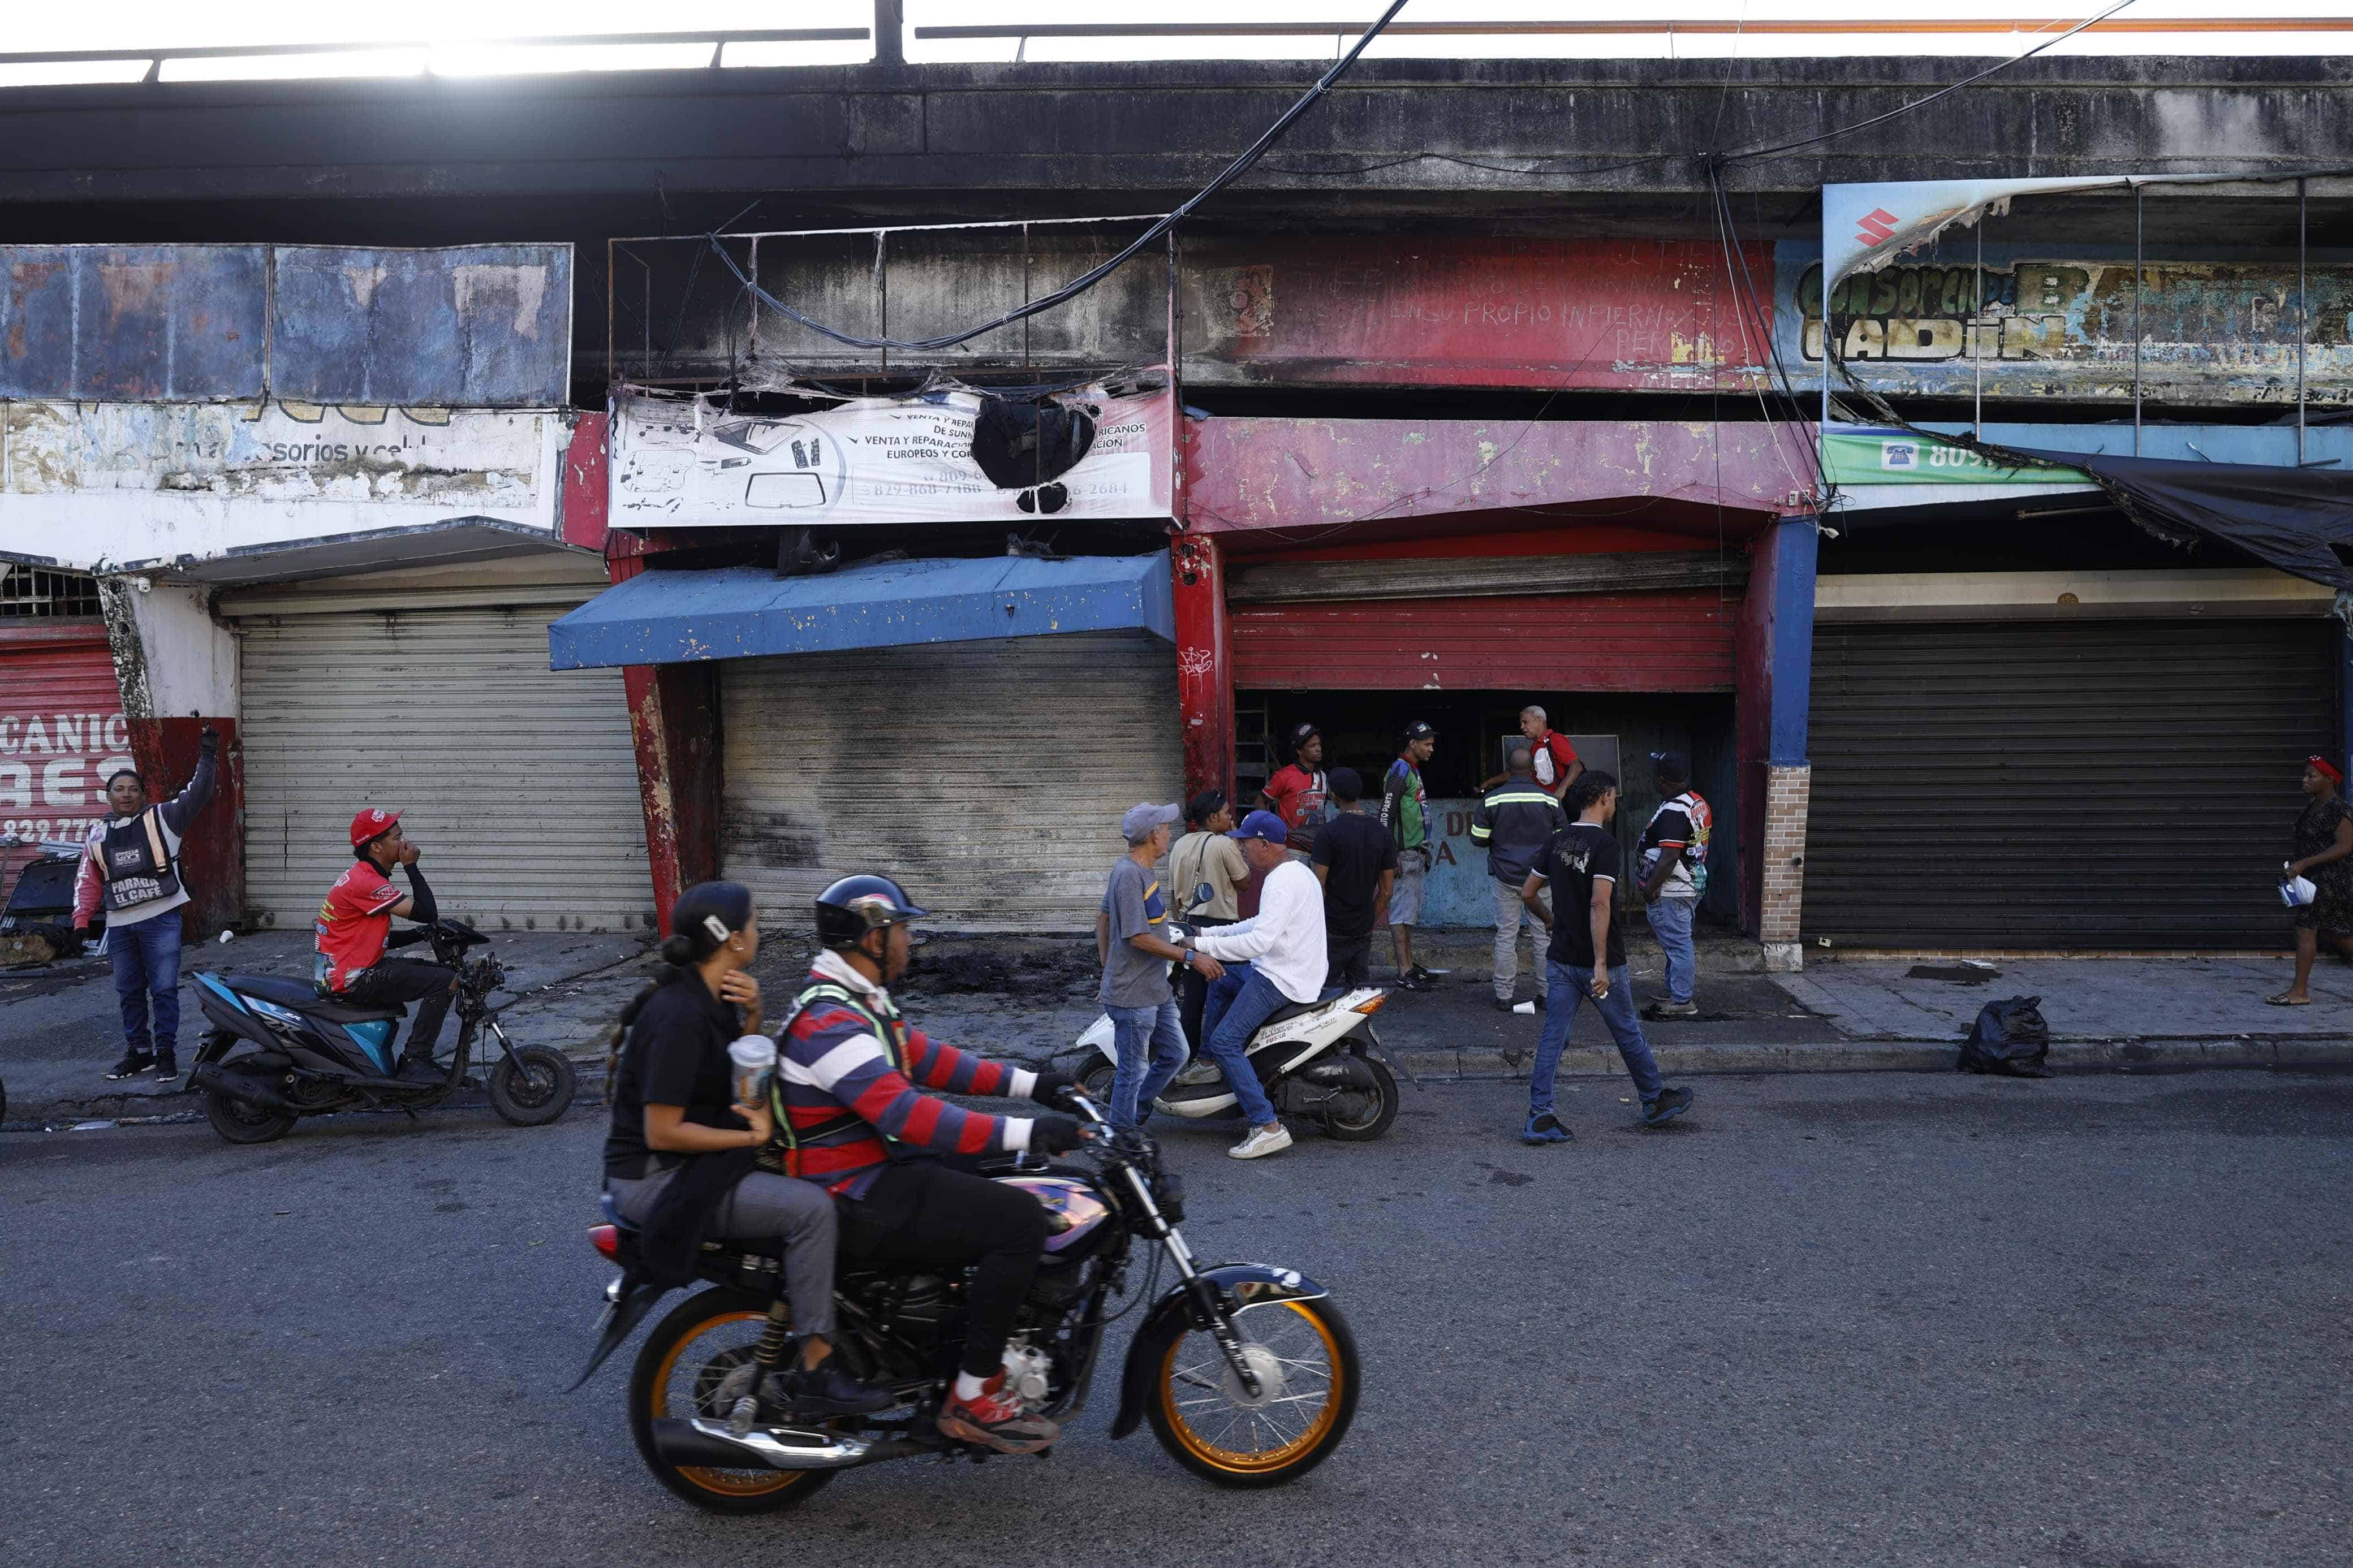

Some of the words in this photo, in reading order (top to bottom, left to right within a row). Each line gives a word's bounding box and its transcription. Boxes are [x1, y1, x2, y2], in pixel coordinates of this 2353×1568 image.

[1464, 301, 1551, 326] PROPIO
[934, 425, 946, 435] DE
[865, 436, 900, 445] VENTA
[903, 436, 910, 444] Y
[887, 449, 939, 459] EUROPEOS
[940, 470, 985, 482] 809-6
[114, 893, 128, 904] EL
